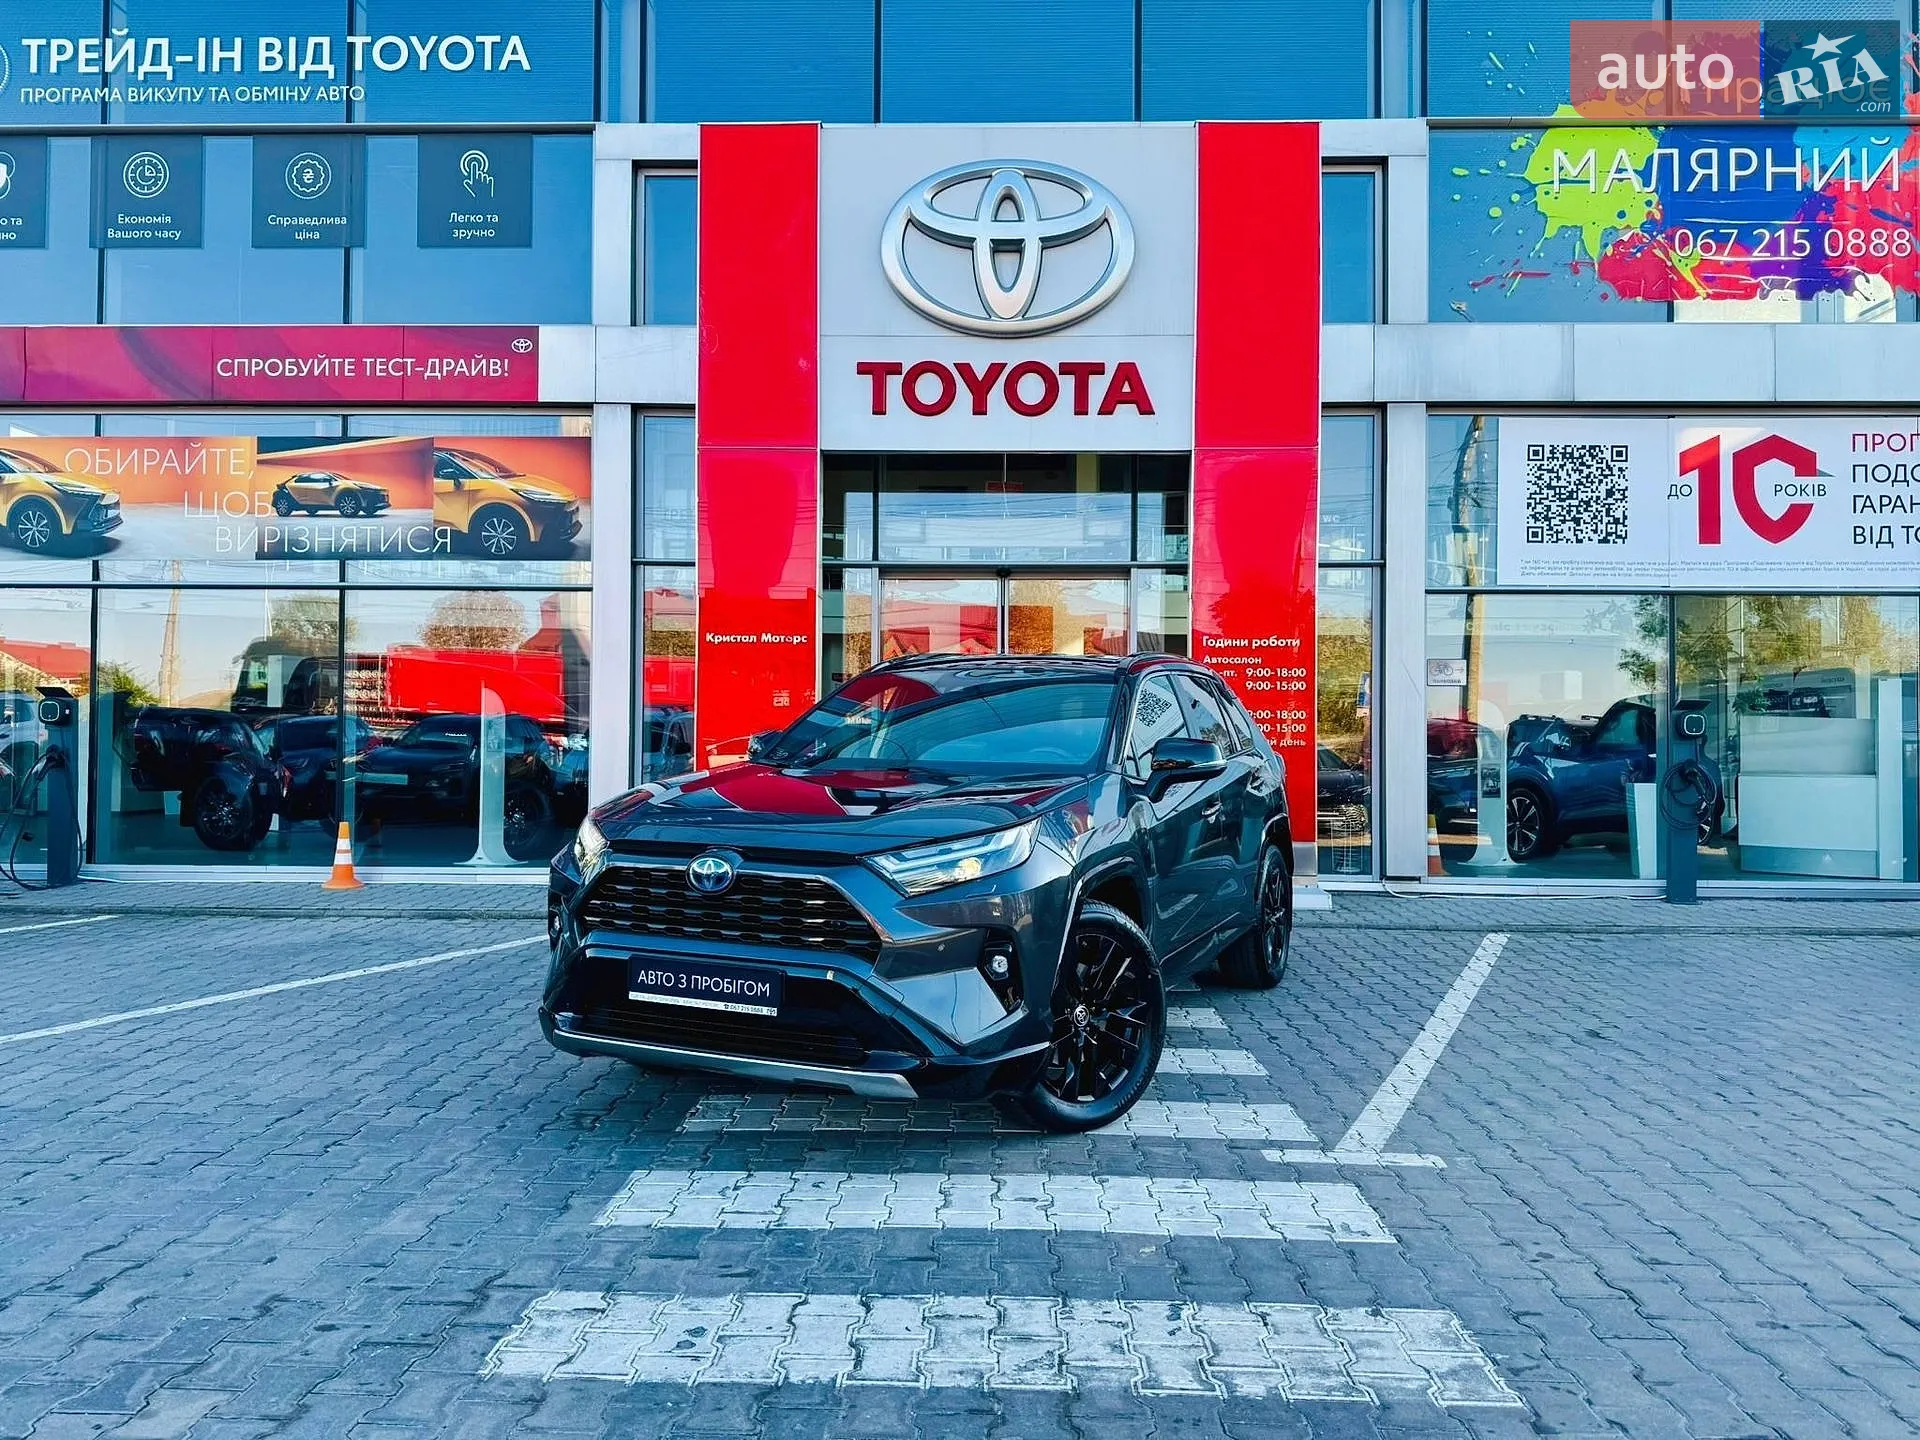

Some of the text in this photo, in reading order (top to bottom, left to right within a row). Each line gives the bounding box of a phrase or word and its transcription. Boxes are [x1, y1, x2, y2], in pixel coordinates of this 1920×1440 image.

[21, 27, 532, 81] ТРЕЙД-ІН ВІД TOYOTA
[20, 85, 365, 103] ПРОГРАМА ВИКУПУ ТА ОБМІНУ АВТО
[1552, 136, 1900, 192] МАЛЯРНИЙ
[117, 213, 172, 224] Економія
[267, 214, 347, 226] Справедлива
[449, 212, 499, 223] Легко та
[107, 228, 182, 241] Вашого часу
[295, 229, 320, 240] ціна
[452, 228, 495, 239] зручно
[1674, 228, 1912, 258] 067 215 0888
[216, 353, 509, 381] СПРОБУЙТЕ ТЕСТ-ДРАЙВ!
[856, 360, 1156, 417] TOYOTA
[64, 442, 255, 480] ОБИРАЙТЕ,
[1667, 483, 1693, 500] ДО
[1773, 483, 1827, 498] РОКІВ
[184, 491, 272, 521] ЩОБ
[215, 525, 452, 554] ВИРІЗНЯТИСЯ
[1852, 525, 1895, 549] ВІД
[705, 632, 808, 645] Кристал Моторс
[1202, 634, 1301, 651] Години роботи
[1202, 655, 1262, 665] Автосалон
[1279, 737, 1307, 747] день
[637, 969, 675, 987] АВТО
[691, 975, 770, 998] ПРОБІГОМ
